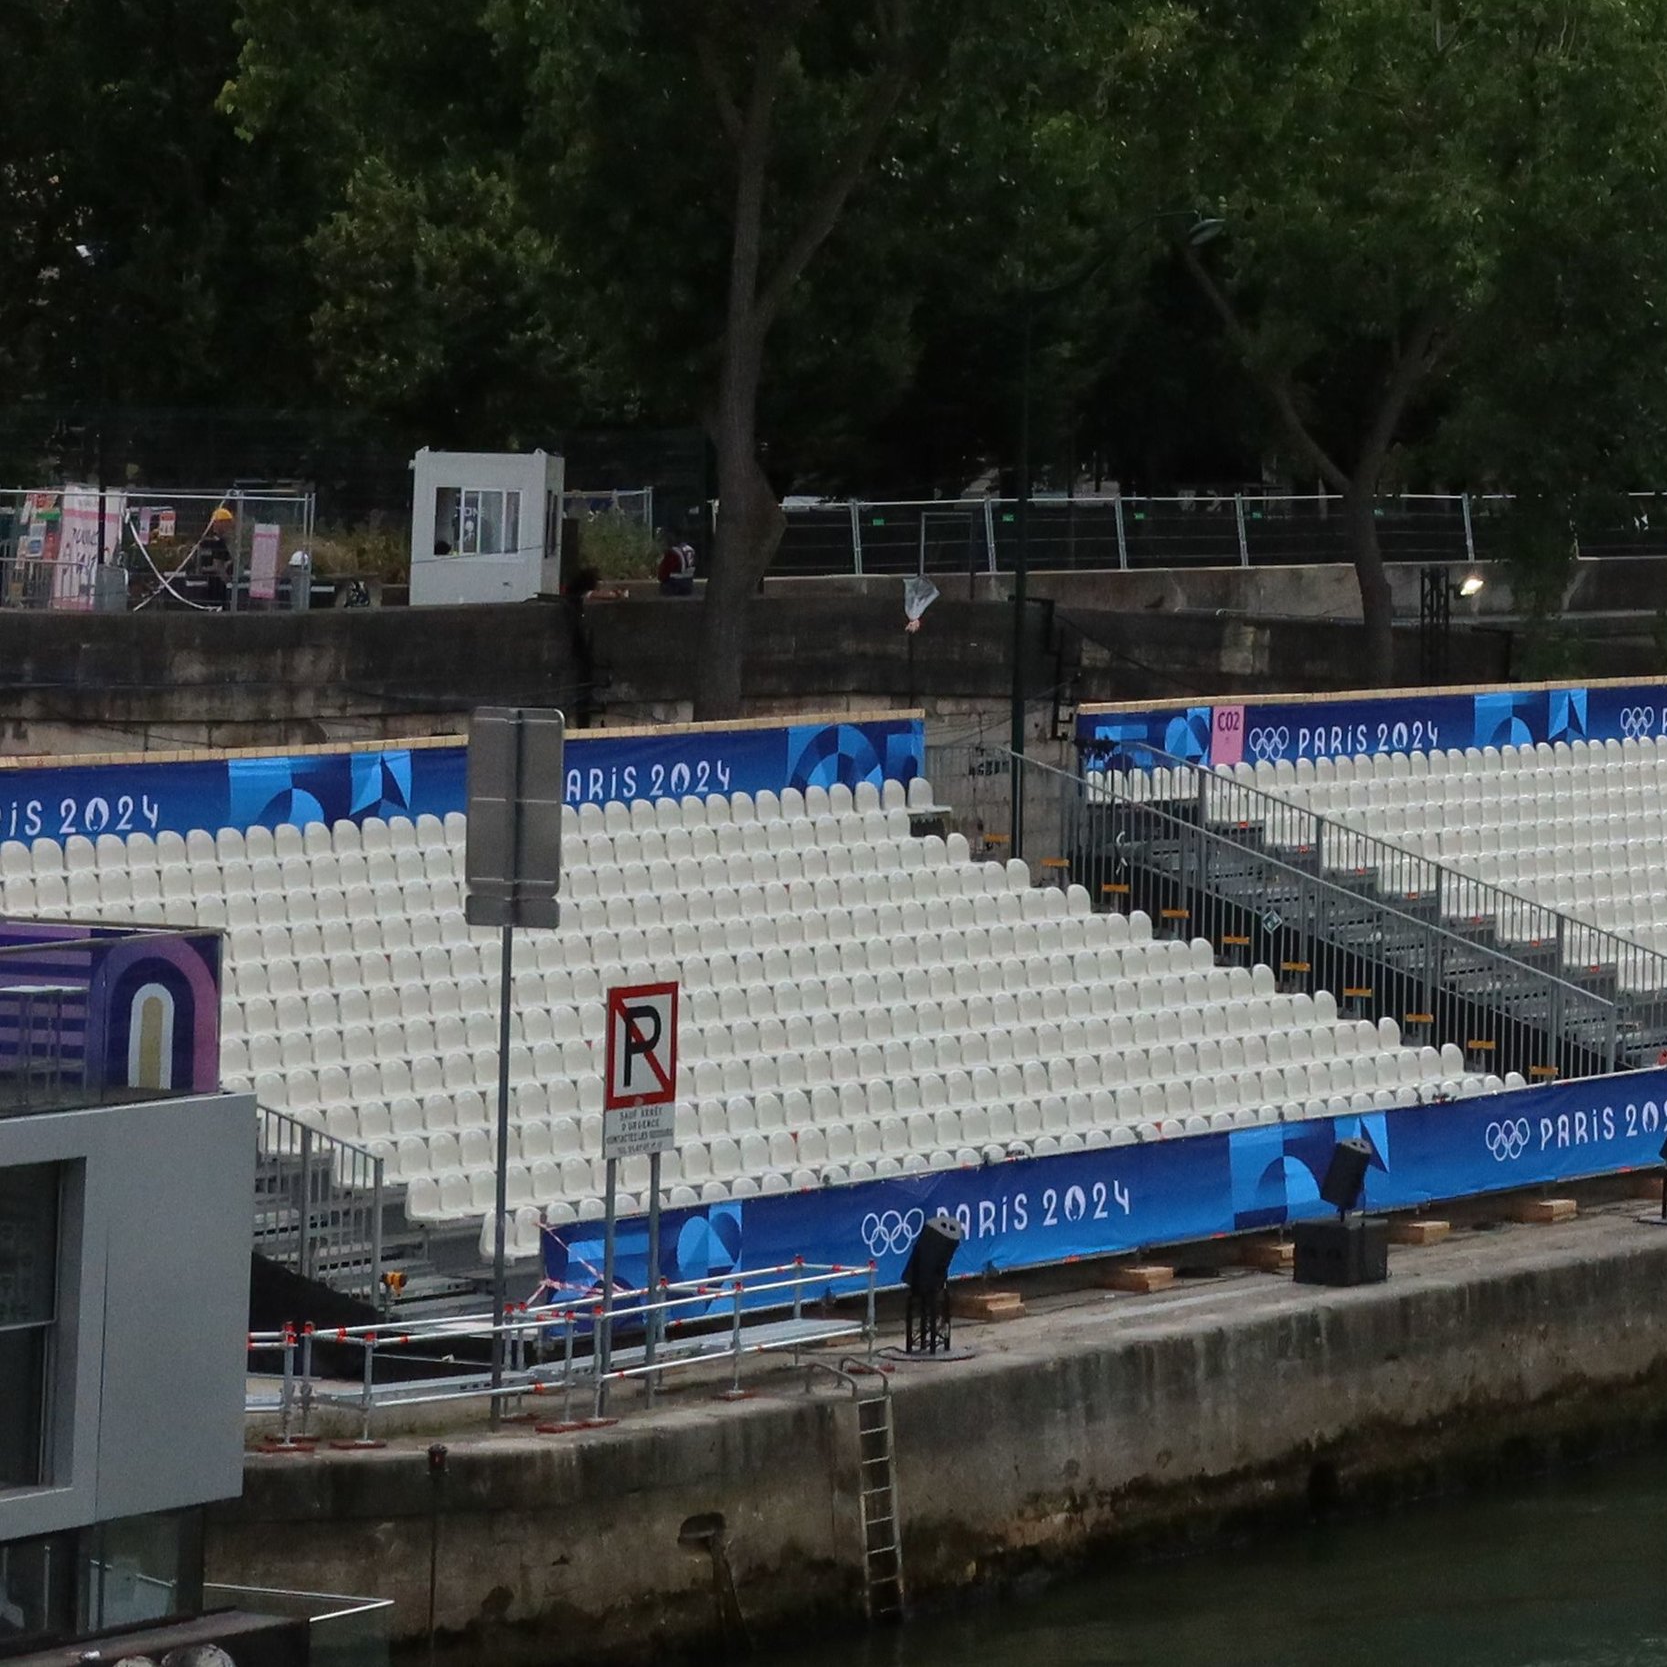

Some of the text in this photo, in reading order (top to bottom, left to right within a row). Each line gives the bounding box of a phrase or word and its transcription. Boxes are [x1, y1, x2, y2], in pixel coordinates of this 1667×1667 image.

[1217, 712, 1240, 731] C02
[1377, 721, 1439, 752] 2024
[650, 759, 730, 797] 2024
[59, 795, 159, 834] 2024
[624, 1005, 661, 1088] P
[1043, 1180, 1130, 1226] 2024
